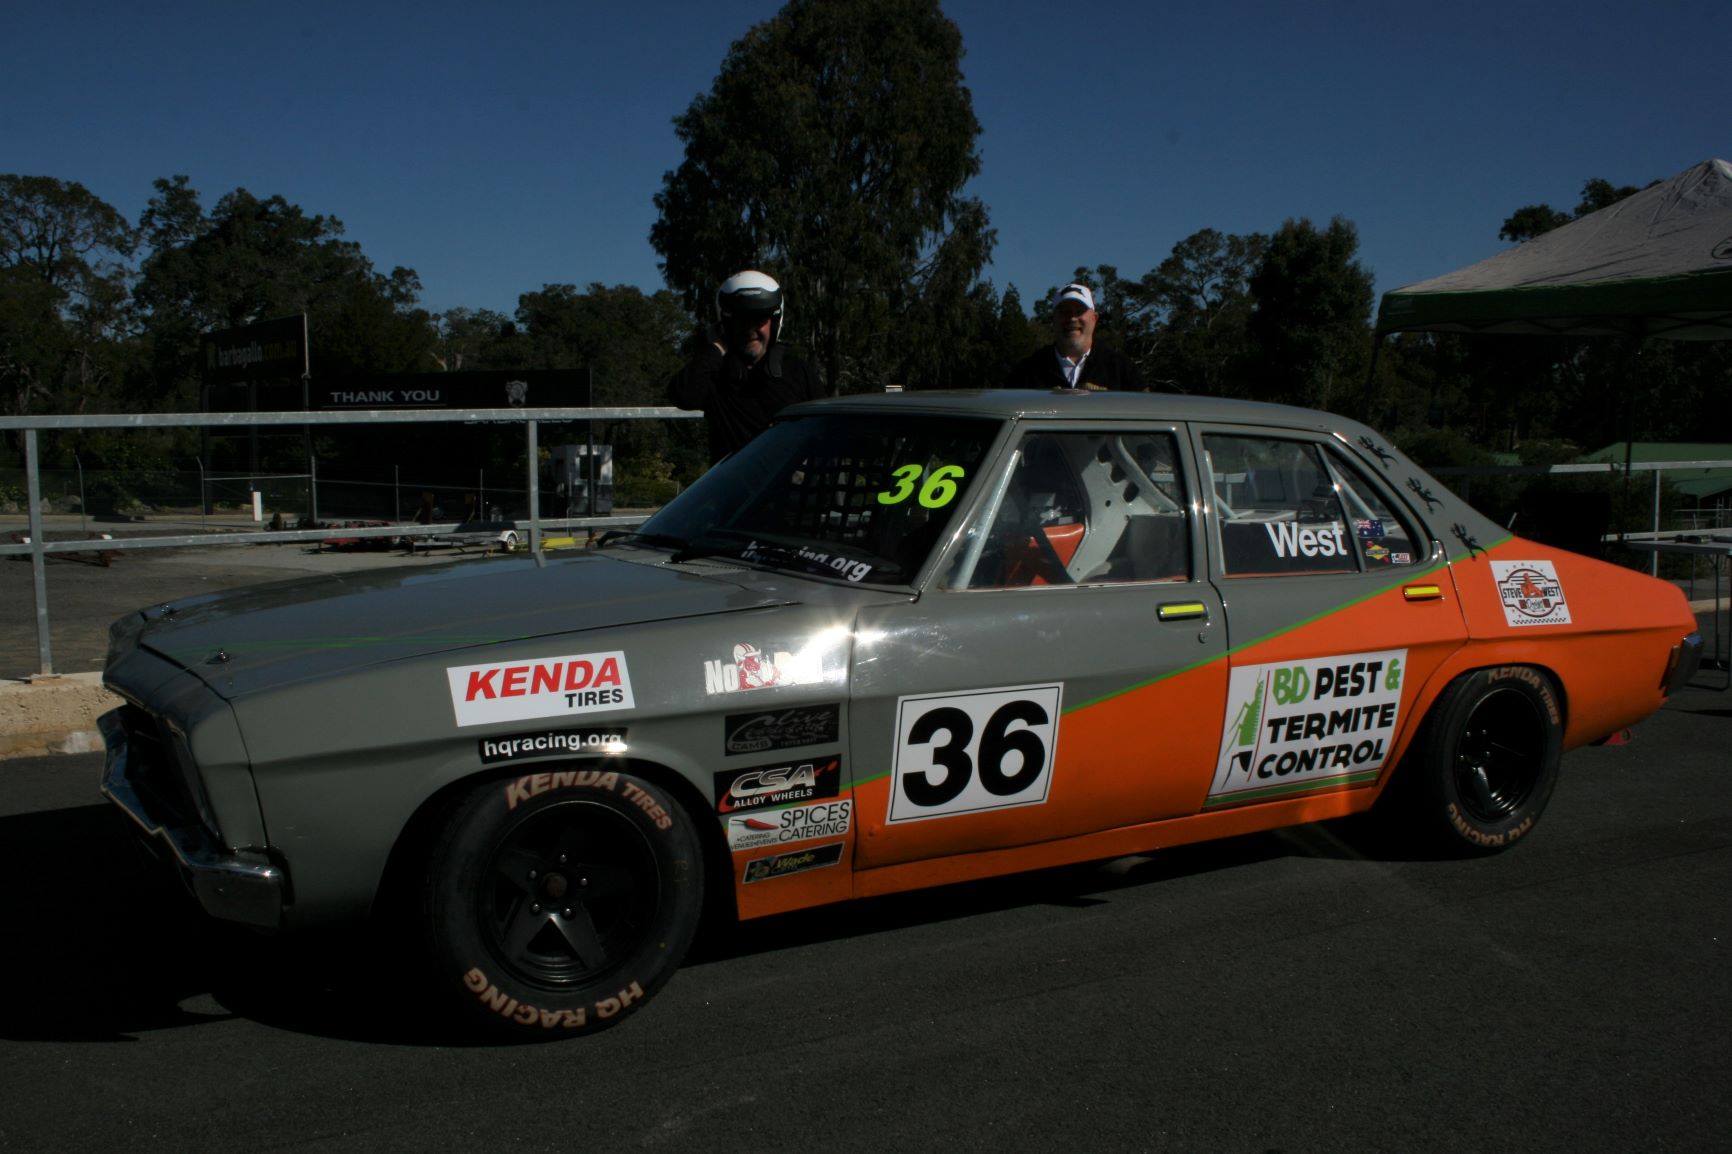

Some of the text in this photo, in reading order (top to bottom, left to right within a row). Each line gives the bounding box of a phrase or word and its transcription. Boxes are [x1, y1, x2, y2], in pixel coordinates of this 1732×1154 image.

[330, 389, 440, 403] THANK YOU
[878, 464, 965, 509] 36
[1265, 521, 1348, 558] West
[1502, 586, 1559, 598] STEVE WEST
[465, 657, 621, 701] KENDA
[1273, 658, 1401, 706] BD PEST &
[1488, 666, 1542, 686] KENDA
[565, 689, 624, 707] TIRES
[1267, 702, 1396, 744] TERMITE
[732, 741, 769, 750] CAMS
[903, 700, 1048, 807] 36
[1257, 739, 1384, 779] CONTROL
[730, 765, 816, 797] CSA
[734, 788, 813, 808] ALLOY WHEELS
[505, 771, 673, 831] KENDA TIRES
[780, 802, 850, 828] SPICES
[779, 821, 847, 841] CATERING
[1447, 802, 1534, 847] HQ RACING
[463, 966, 645, 1029] HQ RACING
